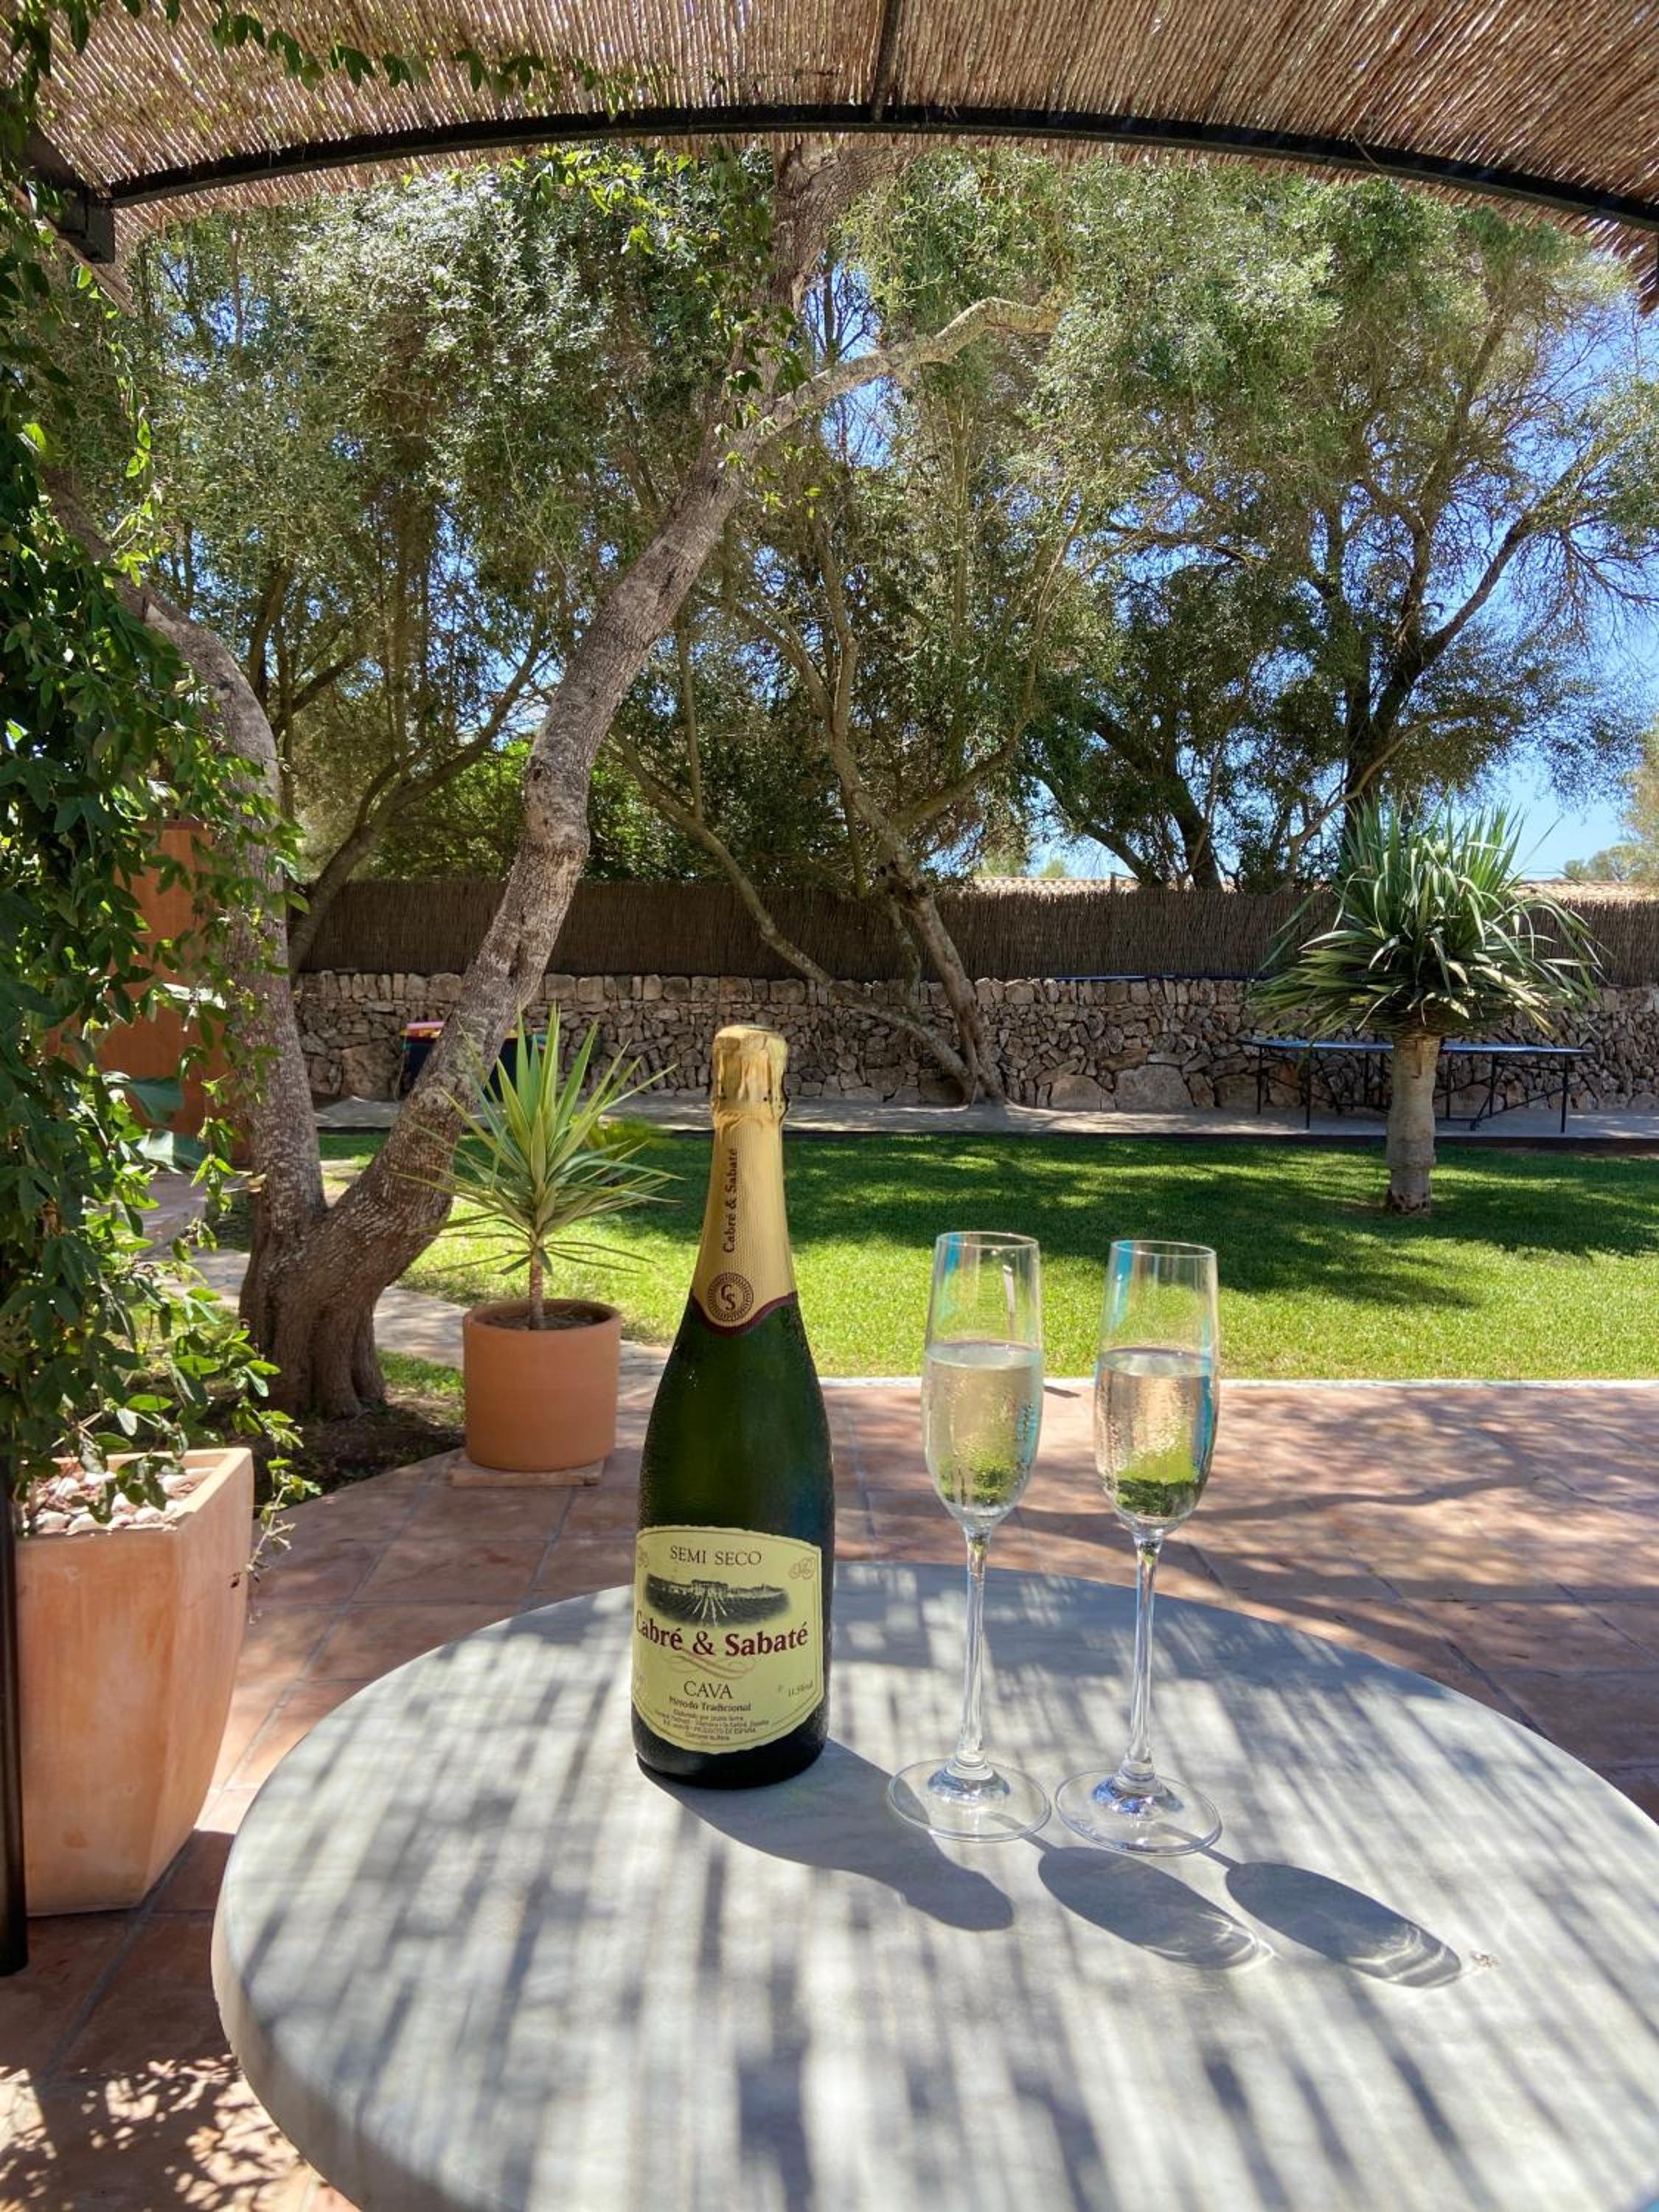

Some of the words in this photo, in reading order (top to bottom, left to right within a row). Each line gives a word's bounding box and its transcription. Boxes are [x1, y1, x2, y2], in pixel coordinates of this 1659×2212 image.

[725, 1197, 737, 1210] &
[670, 1545, 706, 1564] SEMI
[714, 1551, 762, 1566] SECO
[636, 1610, 684, 1651] Cabré
[692, 1630, 716, 1655] &
[725, 1621, 808, 1657] Sabaté
[683, 1680, 733, 1700] CAVA
[700, 1701, 751, 1711] Tradicional
